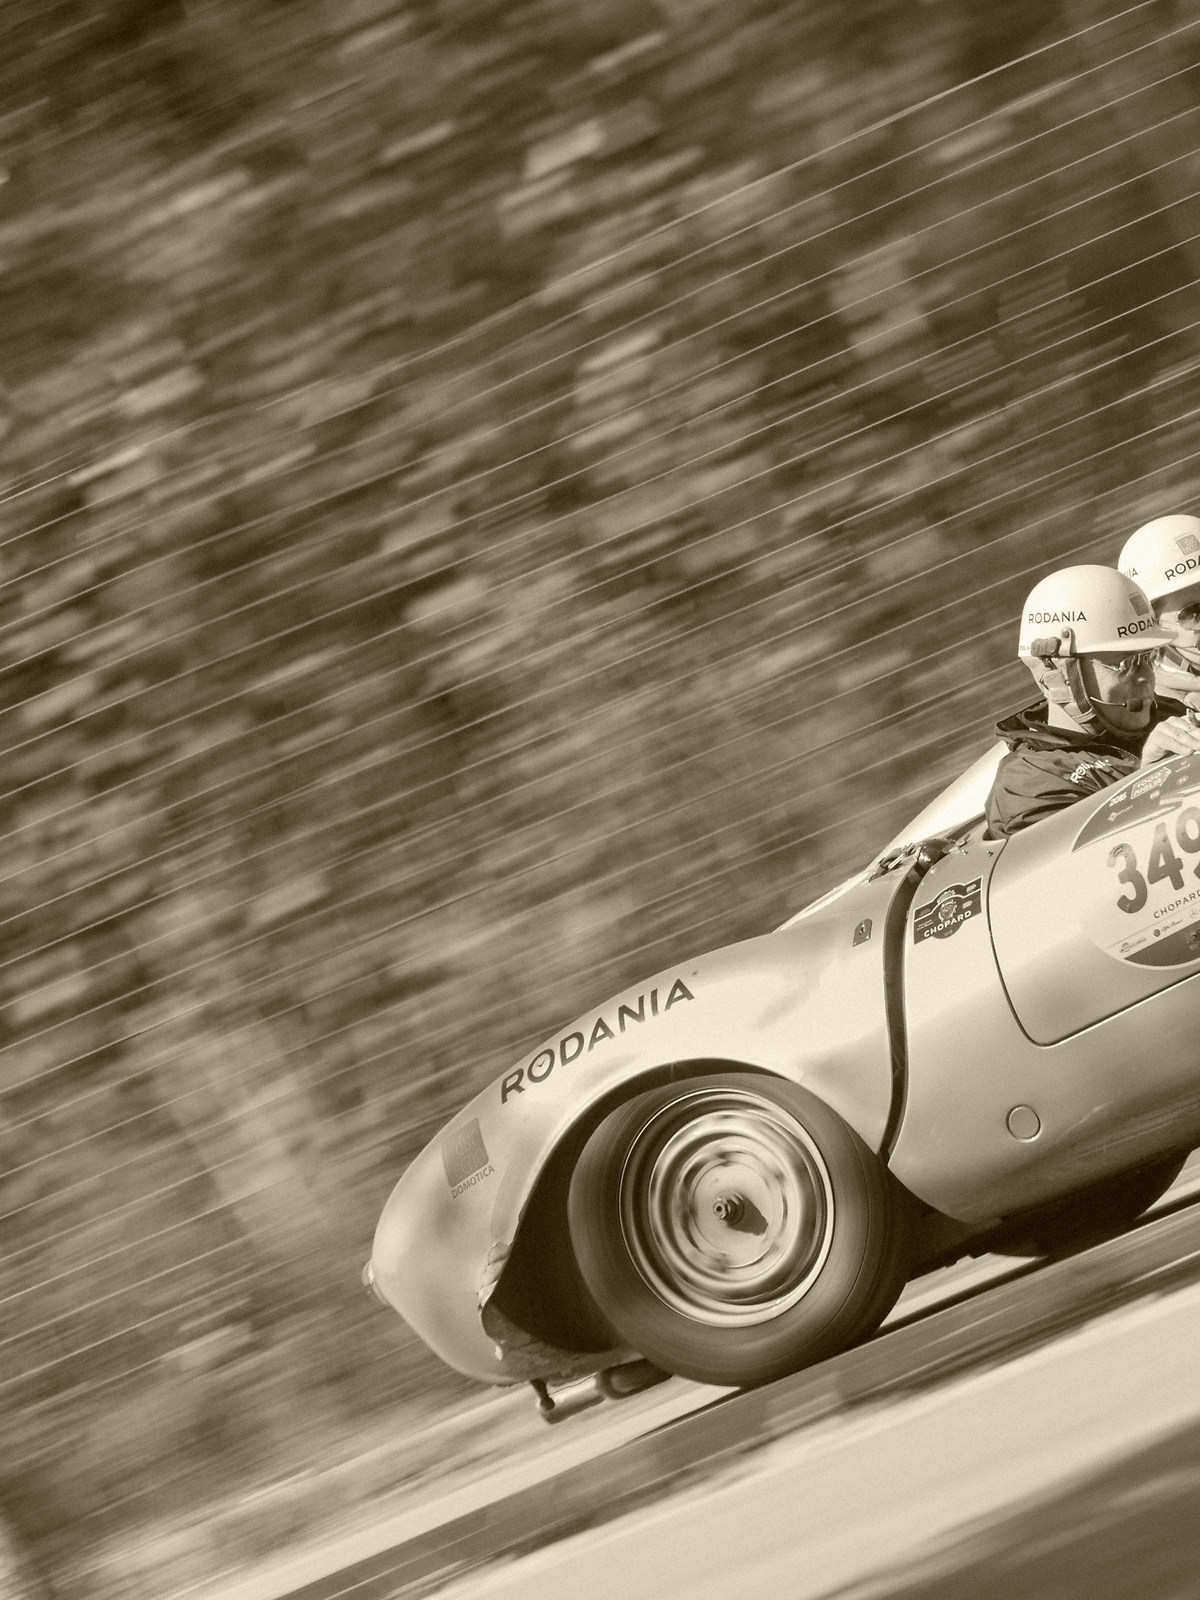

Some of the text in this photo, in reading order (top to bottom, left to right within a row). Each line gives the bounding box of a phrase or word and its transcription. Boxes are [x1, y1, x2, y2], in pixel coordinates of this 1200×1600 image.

[1028, 611, 1087, 624] RODANIA
[1133, 778, 1162, 798] MIGLIA
[923, 910, 972, 938] CHOPARD
[500, 978, 695, 1105] RODANIA
[450, 1165, 495, 1198] DOMOTICA
